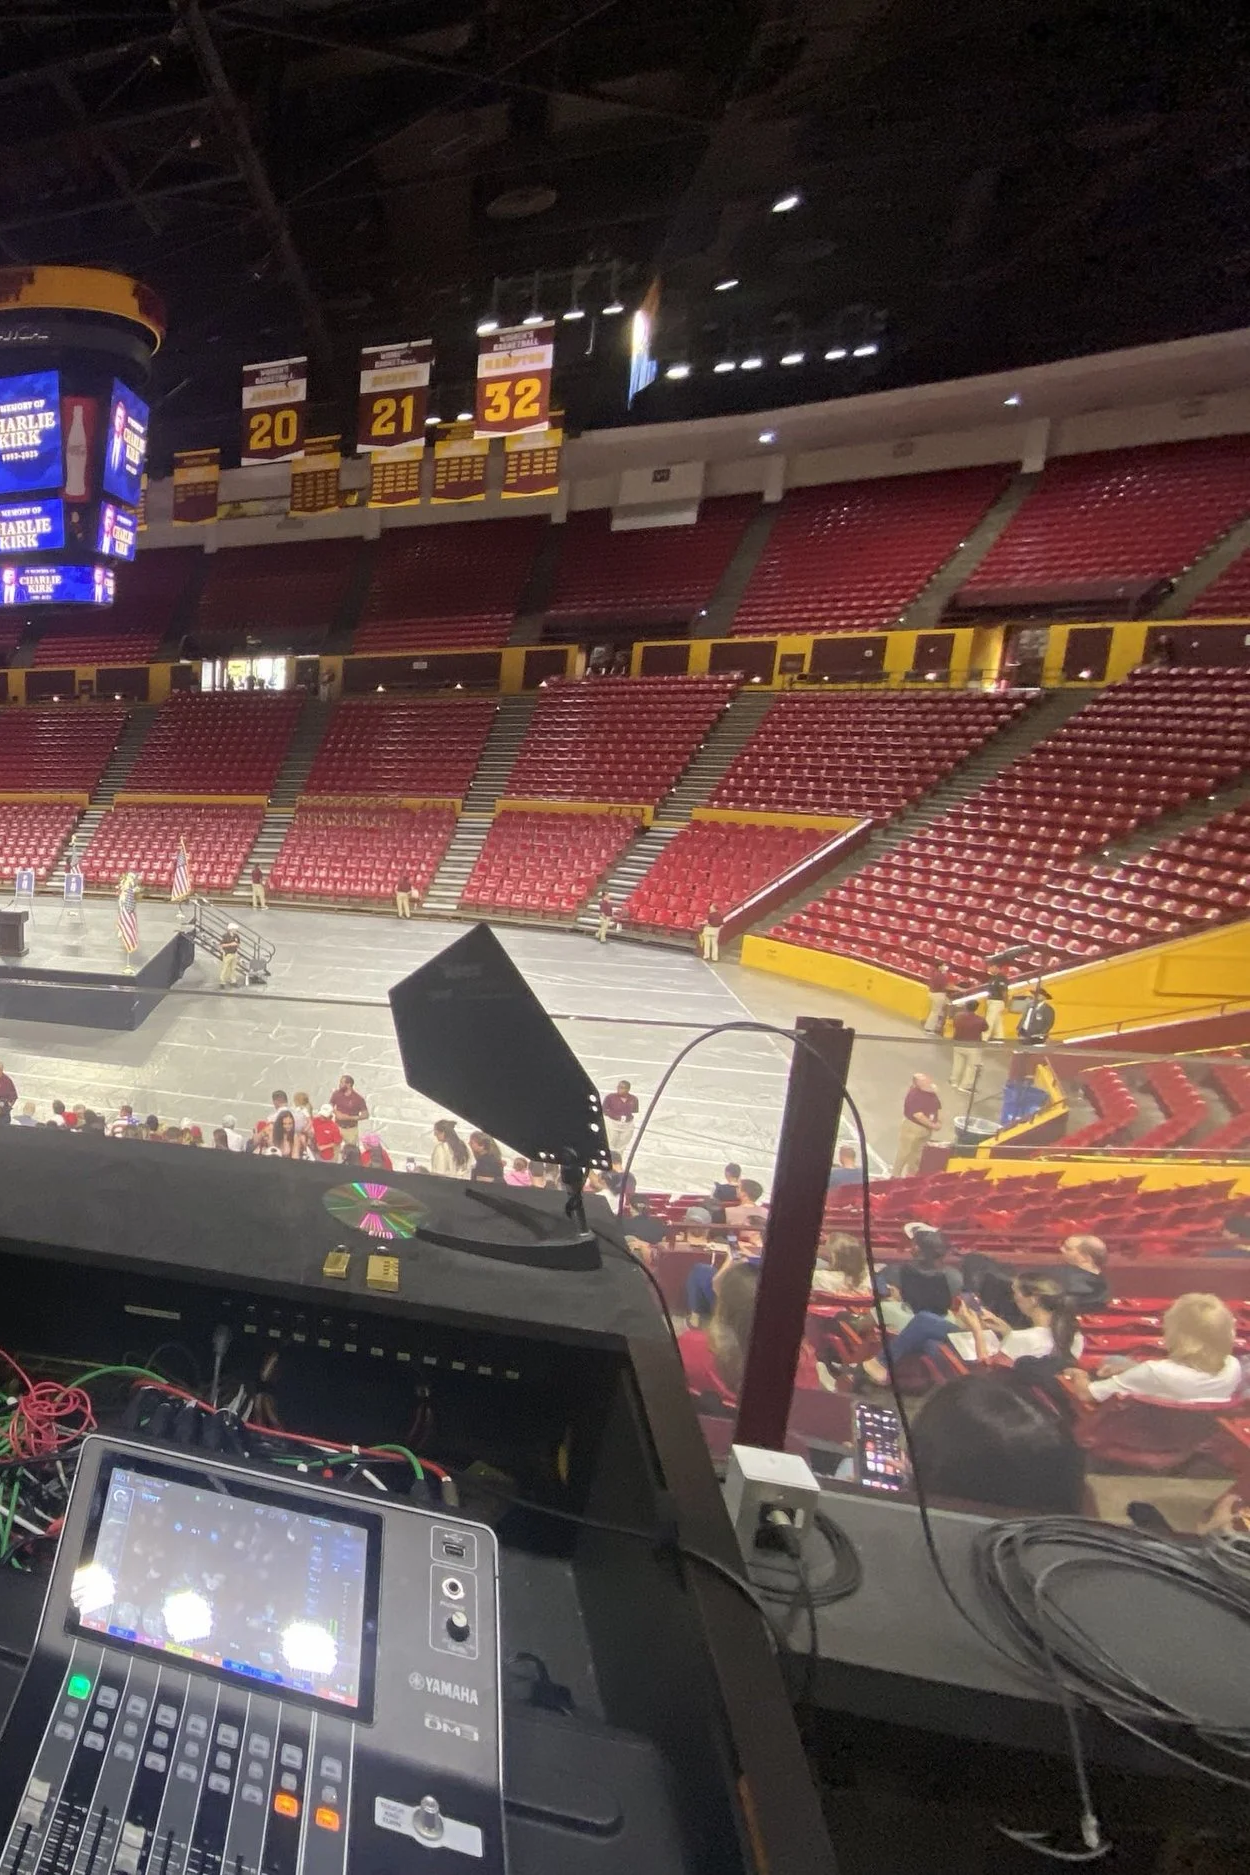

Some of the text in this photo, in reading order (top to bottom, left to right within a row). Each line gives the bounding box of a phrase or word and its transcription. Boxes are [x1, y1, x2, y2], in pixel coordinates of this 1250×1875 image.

[0, 402, 32, 414] MEMORY
[34, 400, 45, 409] OF
[483, 377, 542, 422] 32
[371, 394, 415, 437] 21
[250, 409, 298, 450] 20
[1, 508, 31, 517] MEMORY
[32, 506, 42, 514] OF
[0, 534, 39, 550] KIRK
[19, 575, 62, 586] CHARLIE
[28, 584, 54, 593] KIRK
[425, 1677, 479, 1705] YAMAHA
